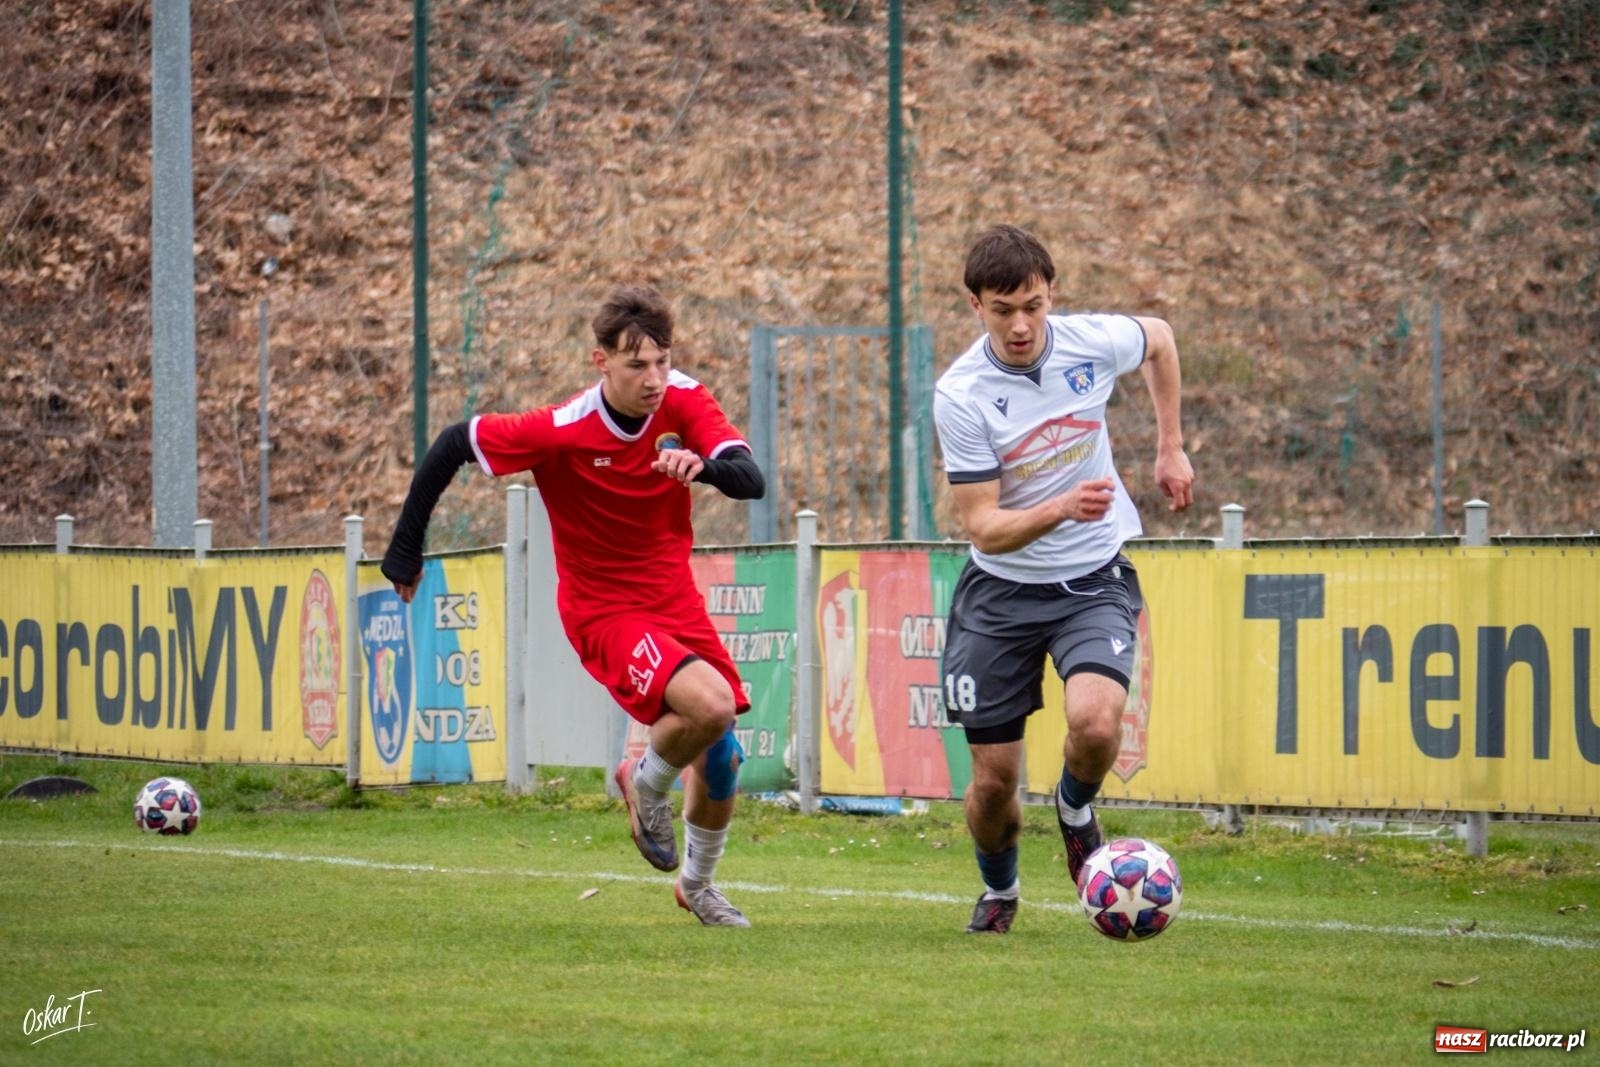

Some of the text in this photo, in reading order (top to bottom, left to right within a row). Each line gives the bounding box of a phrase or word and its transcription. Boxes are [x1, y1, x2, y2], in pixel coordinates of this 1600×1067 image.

[627, 632, 663, 697] 17
[945, 673, 977, 713] 18
[758, 728, 776, 758] 21
